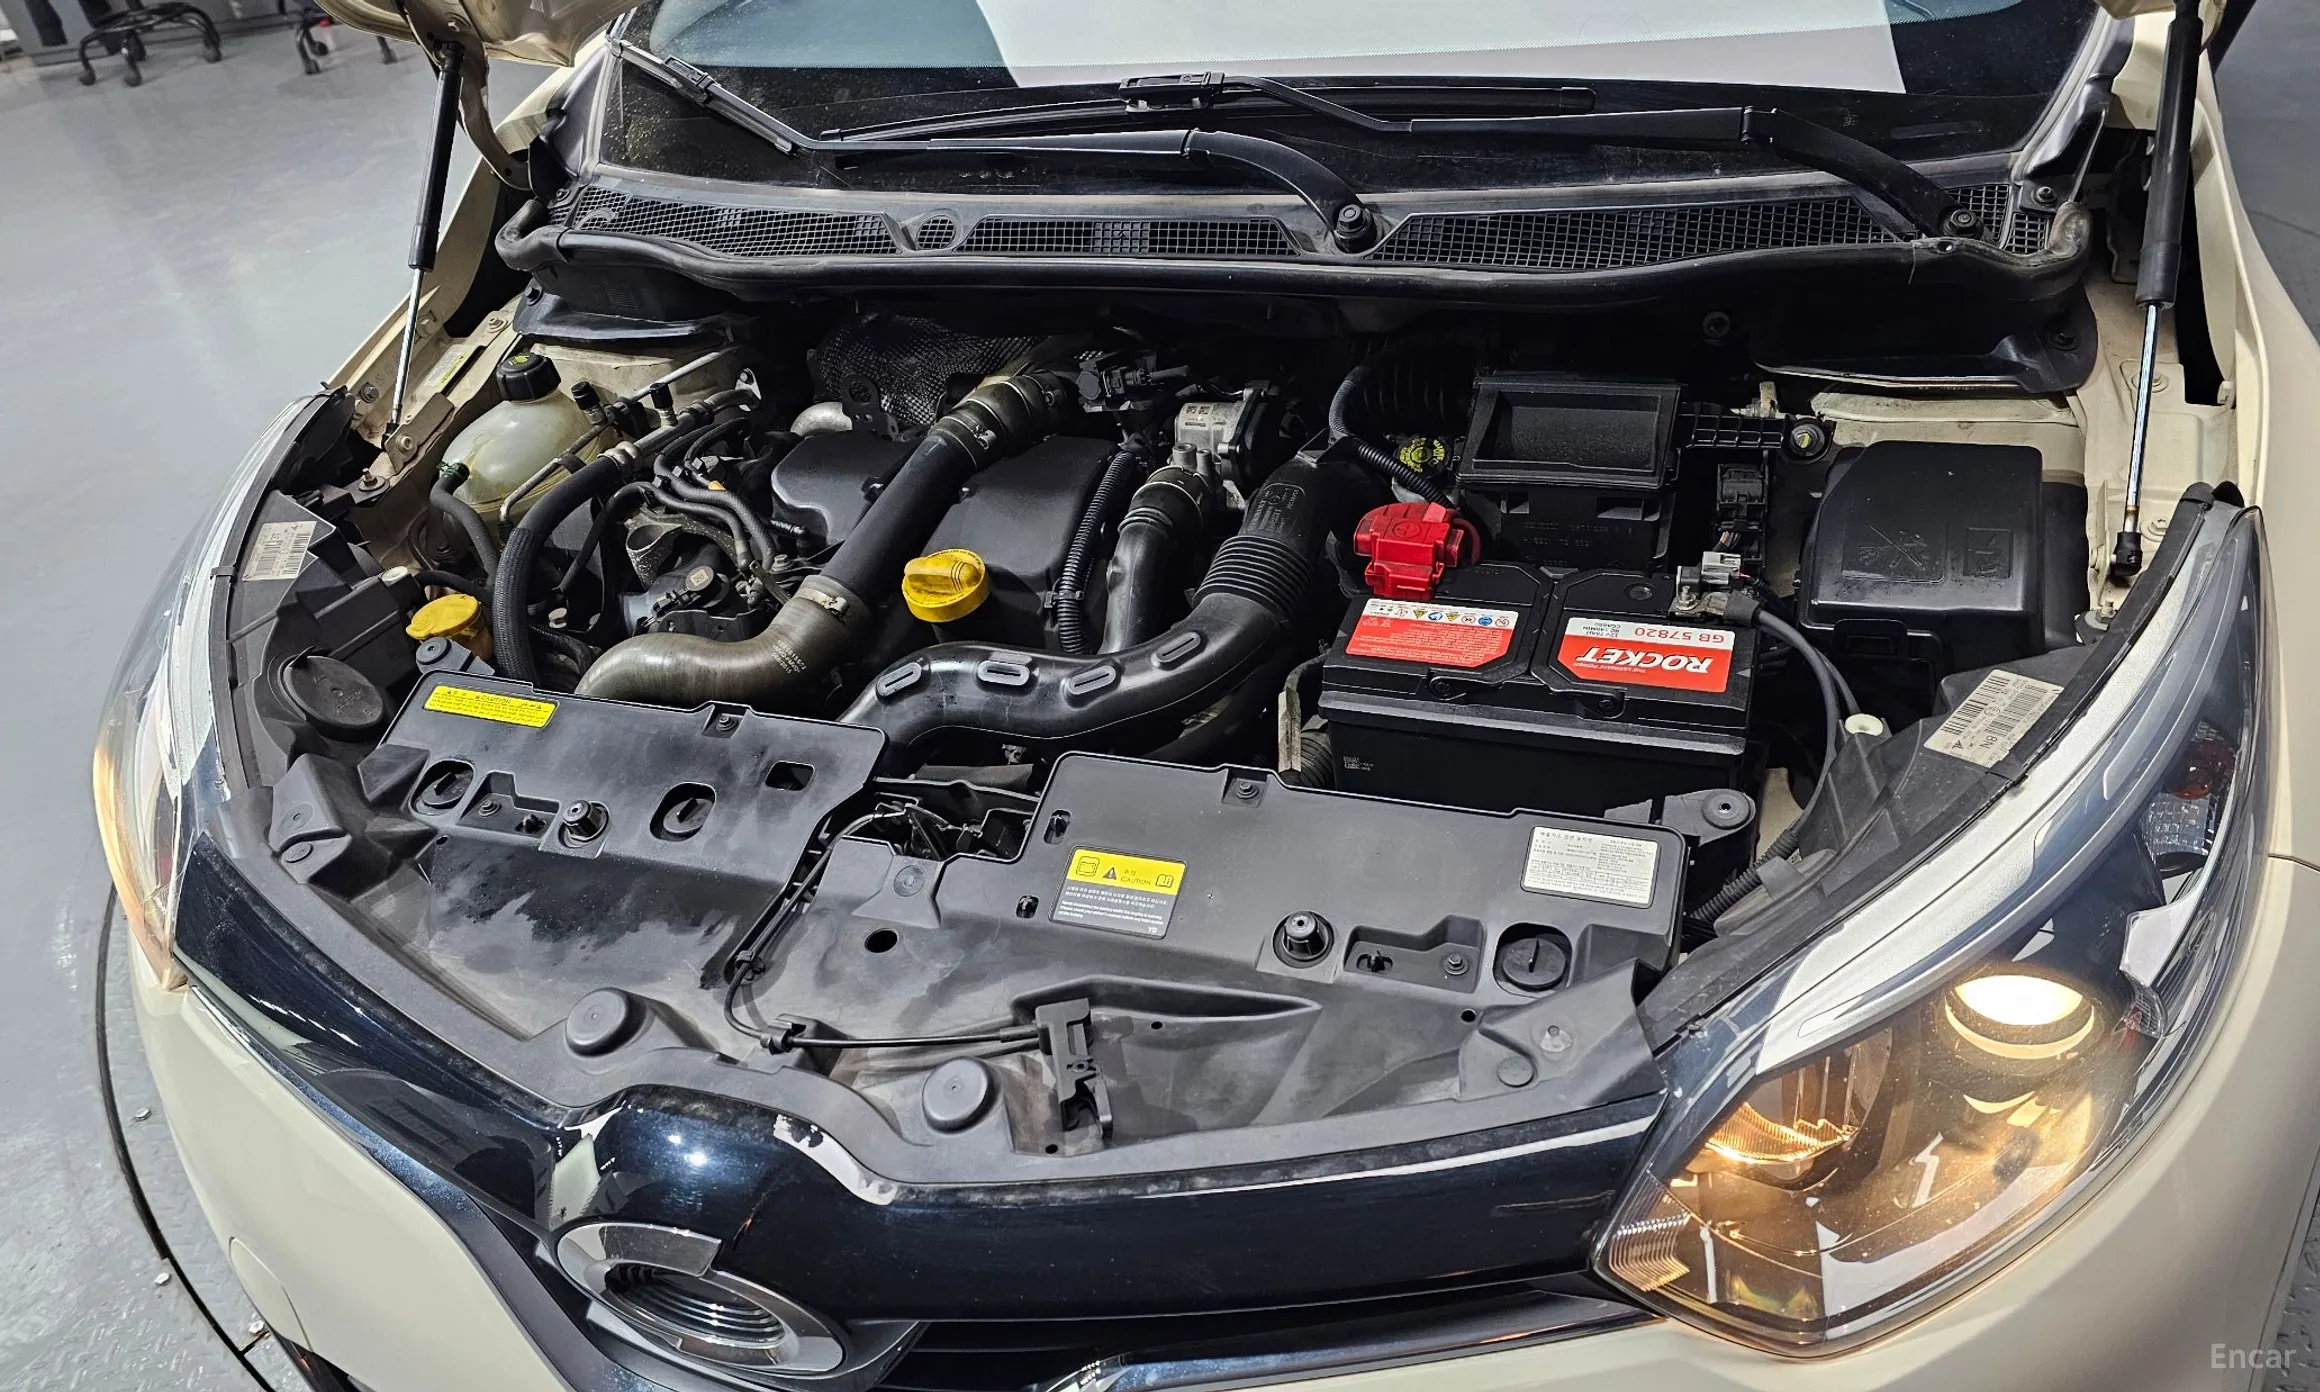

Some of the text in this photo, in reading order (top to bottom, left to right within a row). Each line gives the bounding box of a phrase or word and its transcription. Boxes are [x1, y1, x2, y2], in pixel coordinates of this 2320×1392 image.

[1635, 627, 1724, 643] GB 57820
[1575, 646, 1713, 673] ROCKET
[1978, 735, 1998, 749] N8
[1120, 876, 1151, 886] CAUTION
